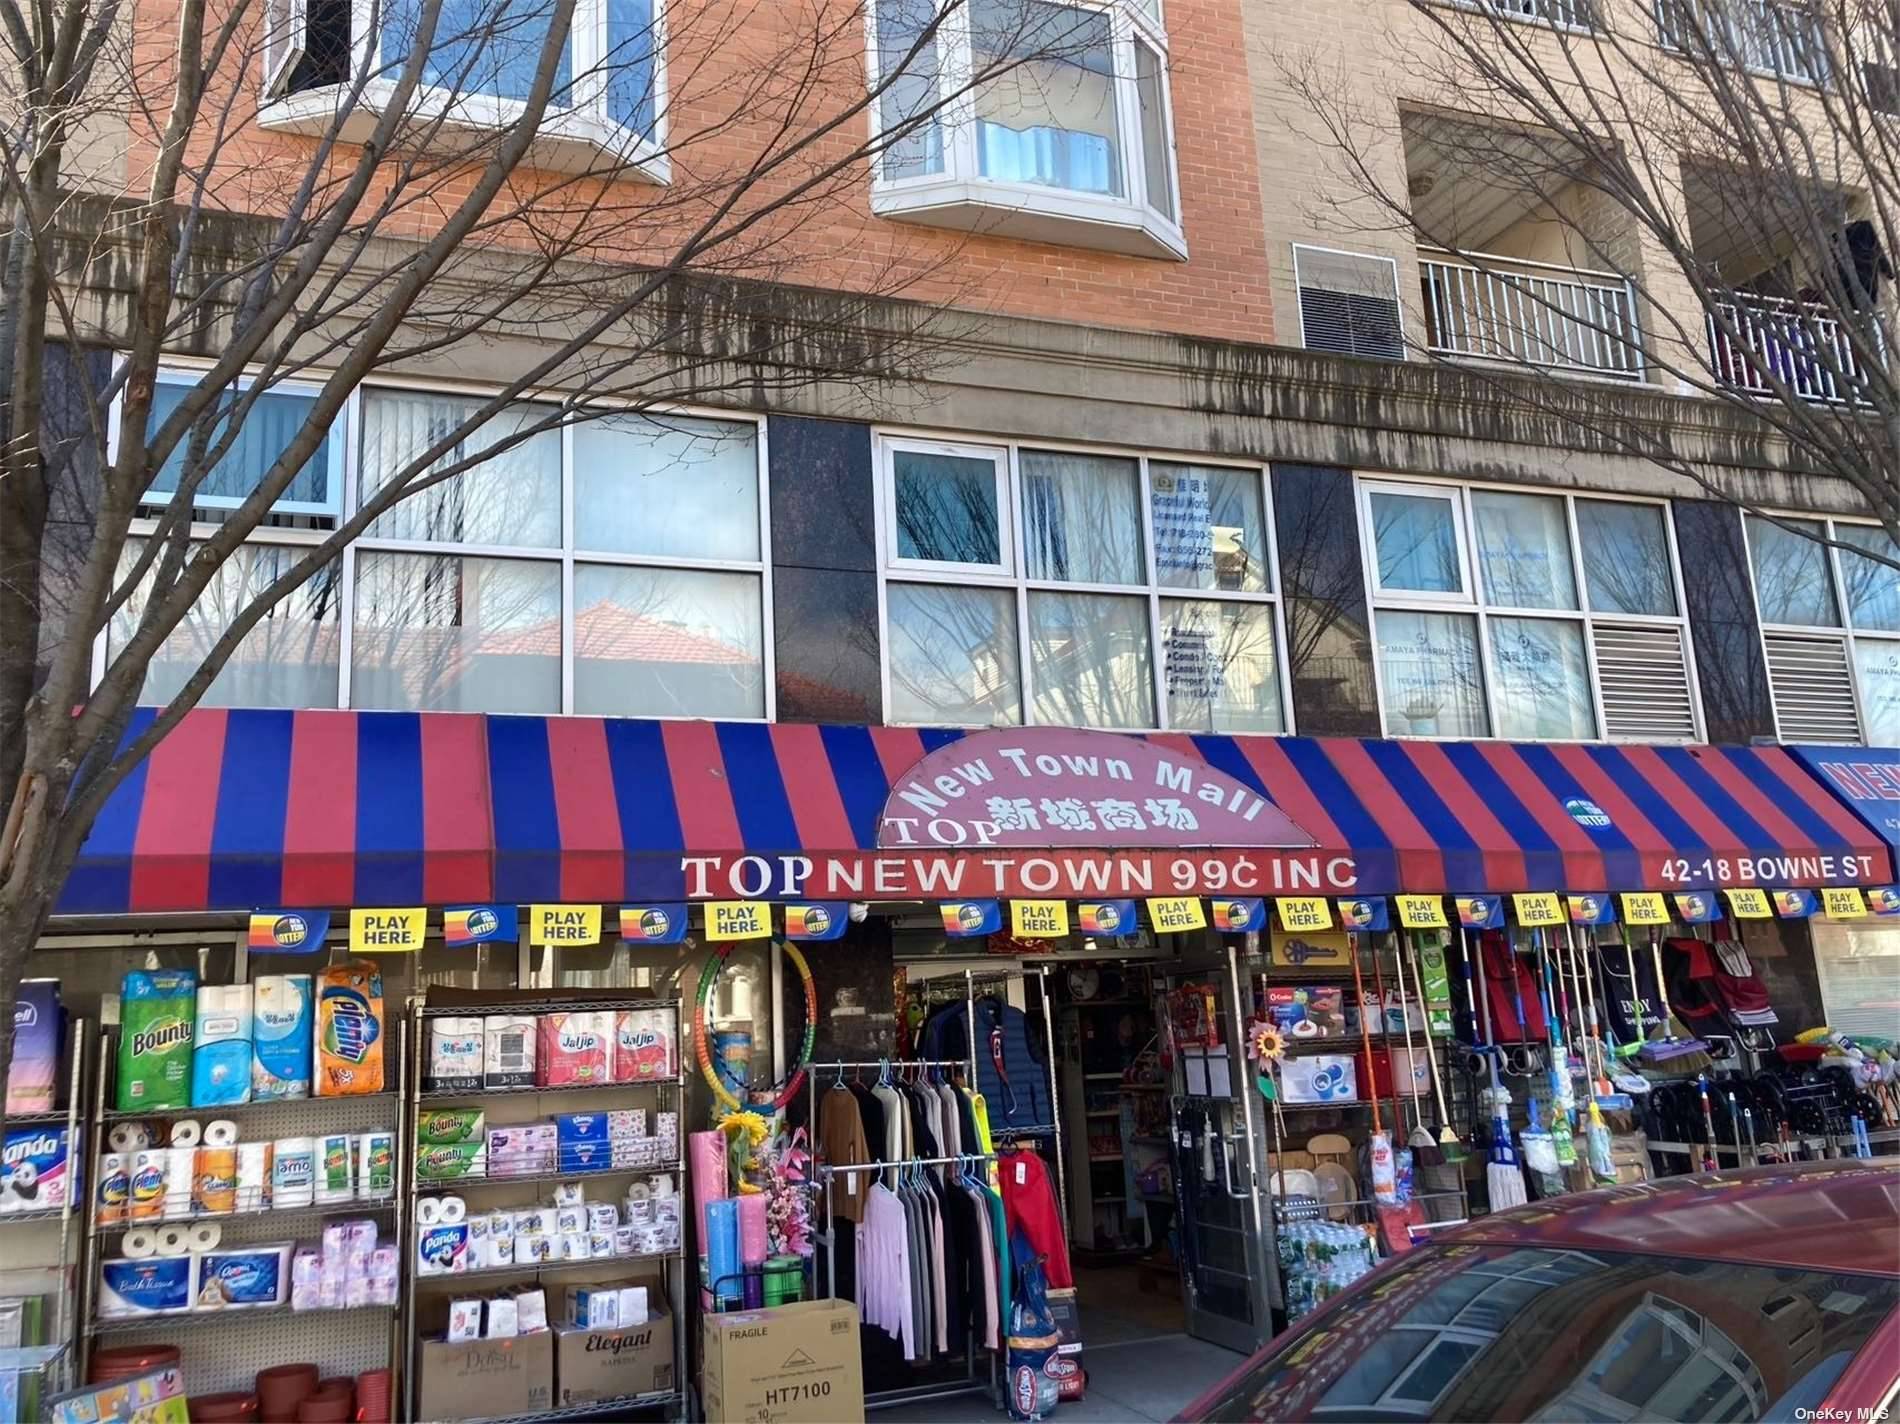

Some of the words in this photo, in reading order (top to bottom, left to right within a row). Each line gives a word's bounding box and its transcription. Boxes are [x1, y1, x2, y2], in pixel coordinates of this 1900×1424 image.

[898, 759, 994, 818] New
[998, 748, 1133, 782] Town
[1155, 760, 1265, 822] Mall
[984, 796, 1200, 831] 新城商场
[884, 817, 1002, 845] TOP
[1660, 858, 1732, 882] 42-18
[1738, 856, 1837, 881] BOWNE
[1841, 855, 1873, 878] ST
[681, 855, 813, 898] TOP
[827, 858, 966, 893] NEW
[983, 858, 1152, 892] TOWN
[1272, 856, 1359, 890] INC
[1522, 898, 1549, 909] PLAY
[1629, 898, 1655, 909] PLAY
[1733, 892, 1757, 903] PLAY
[1829, 893, 1851, 902] PLAY
[717, 906, 757, 921] PLAY
[1021, 906, 1055, 919] PLAY
[1157, 901, 1189, 915] PLAY
[1286, 902, 1316, 915] PLAY
[1406, 901, 1433, 912] PLAY
[1737, 903, 1766, 913] HERE.
[1831, 903, 1861, 913] HERE.
[544, 912, 586, 925] PLAY
[1160, 913, 1199, 927] HERE.
[1288, 913, 1325, 926] HERE.
[1409, 911, 1442, 923] HERE.
[1524, 909, 1558, 921] HERE.
[1631, 908, 1663, 920] HERE.
[364, 916, 410, 930] PLAY
[717, 920, 764, 934] HERE.
[1022, 919, 1061, 932] HERE.
[364, 931, 416, 945] HERE.
[543, 926, 592, 940] HERE.
[132, 1021, 193, 1058] Bounty
[562, 1036, 595, 1050] Jaljip
[622, 1033, 655, 1047] Jaljip
[428, 1116, 463, 1136] Bounty
[729, 1327, 768, 1341] FRAGILE
[585, 1329, 652, 1354] Elegant
[766, 1380, 831, 1406] HT7100
